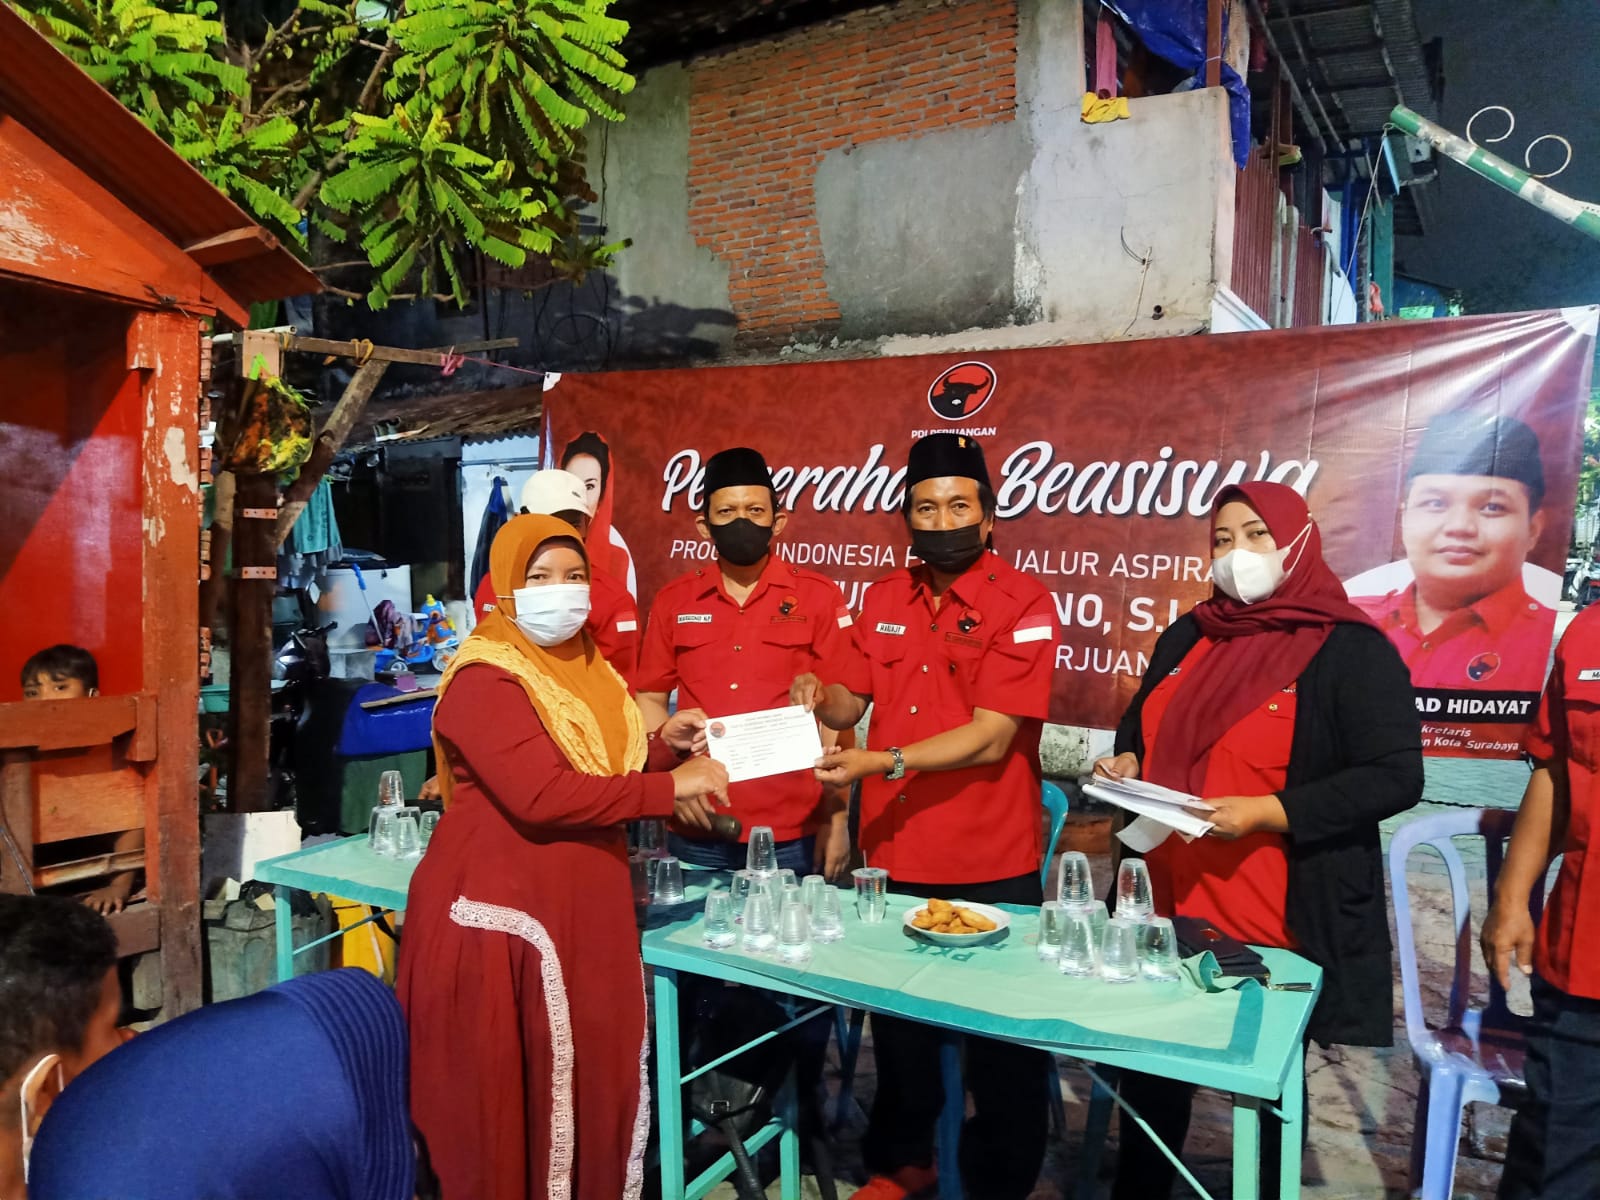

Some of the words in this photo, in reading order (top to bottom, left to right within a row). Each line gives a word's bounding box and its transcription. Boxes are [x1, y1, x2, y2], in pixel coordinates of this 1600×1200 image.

[776, 542, 895, 568] INDONESIA
[1013, 549, 1099, 576] JALUR
[1415, 697, 1441, 712] AD
[1447, 699, 1531, 715] HIDAYAT
[1421, 724, 1472, 737] kretaris
[1433, 736, 1461, 747] Kota
[1465, 740, 1519, 752] Surabaya
